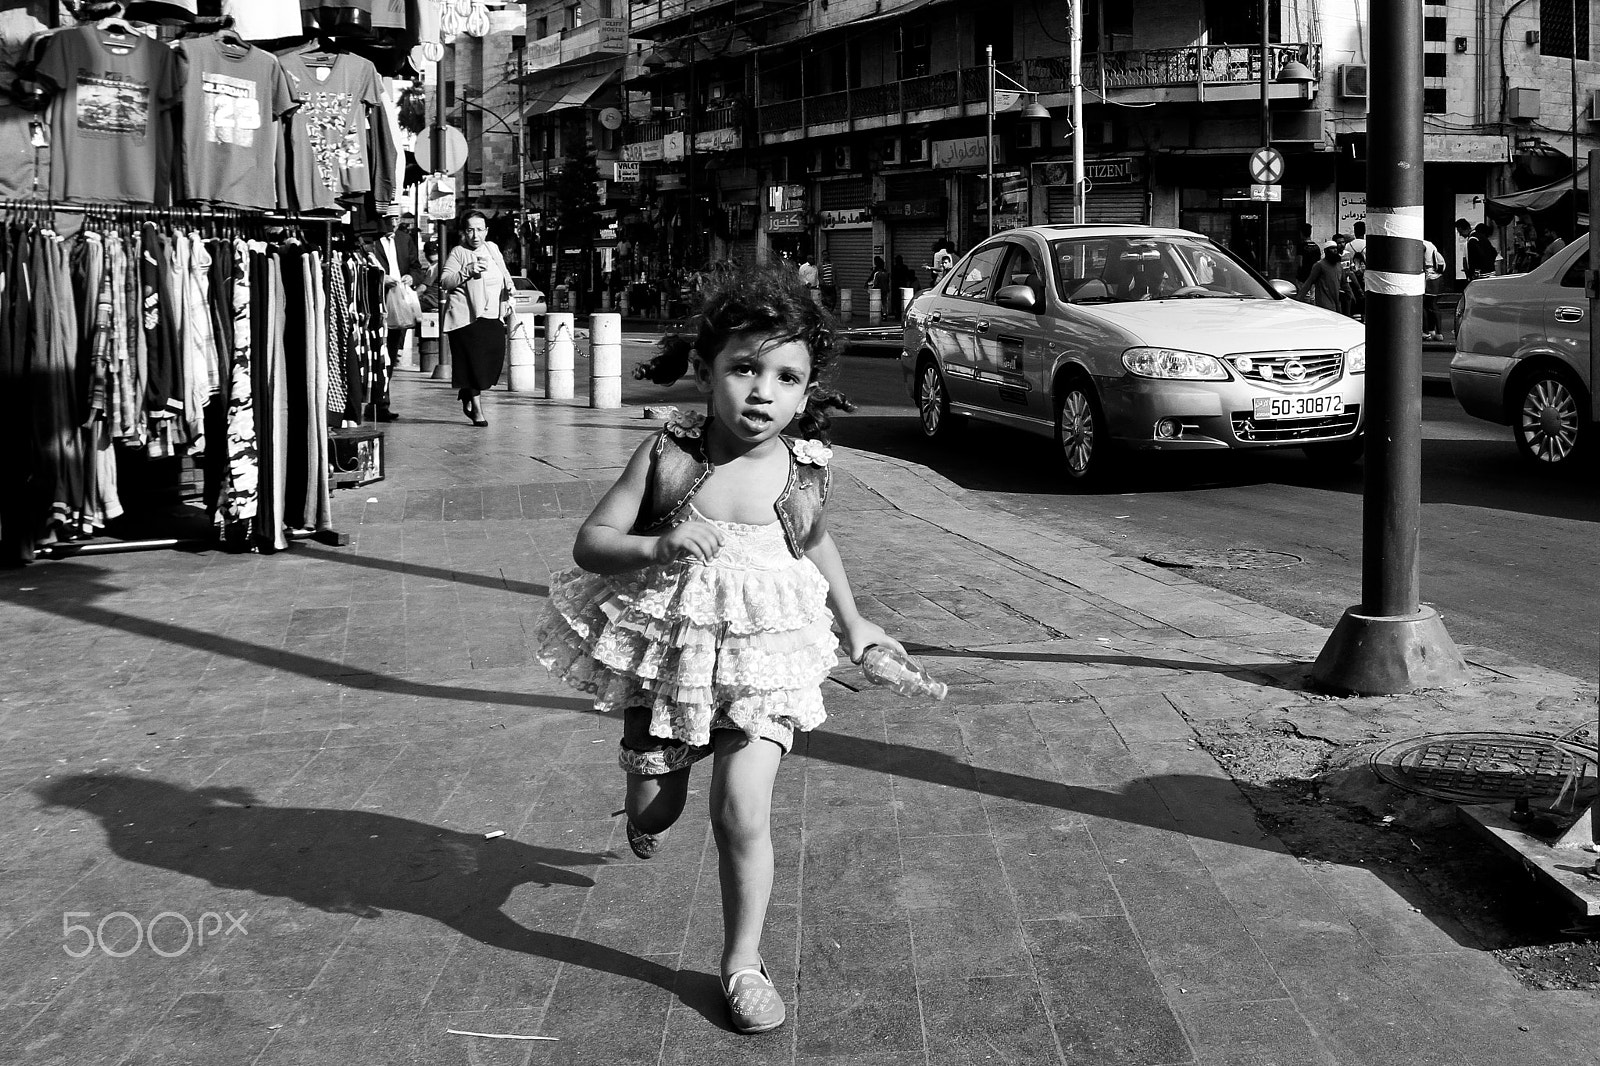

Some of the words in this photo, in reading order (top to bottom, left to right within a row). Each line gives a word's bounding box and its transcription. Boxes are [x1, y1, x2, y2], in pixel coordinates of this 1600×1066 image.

[214, 95, 261, 129] 23
[618, 162, 639, 170] VALET
[1083, 163, 1124, 178] TIZEN
[768, 214, 800, 231] كنوز
[1271, 395, 1342, 416] 50-30872
